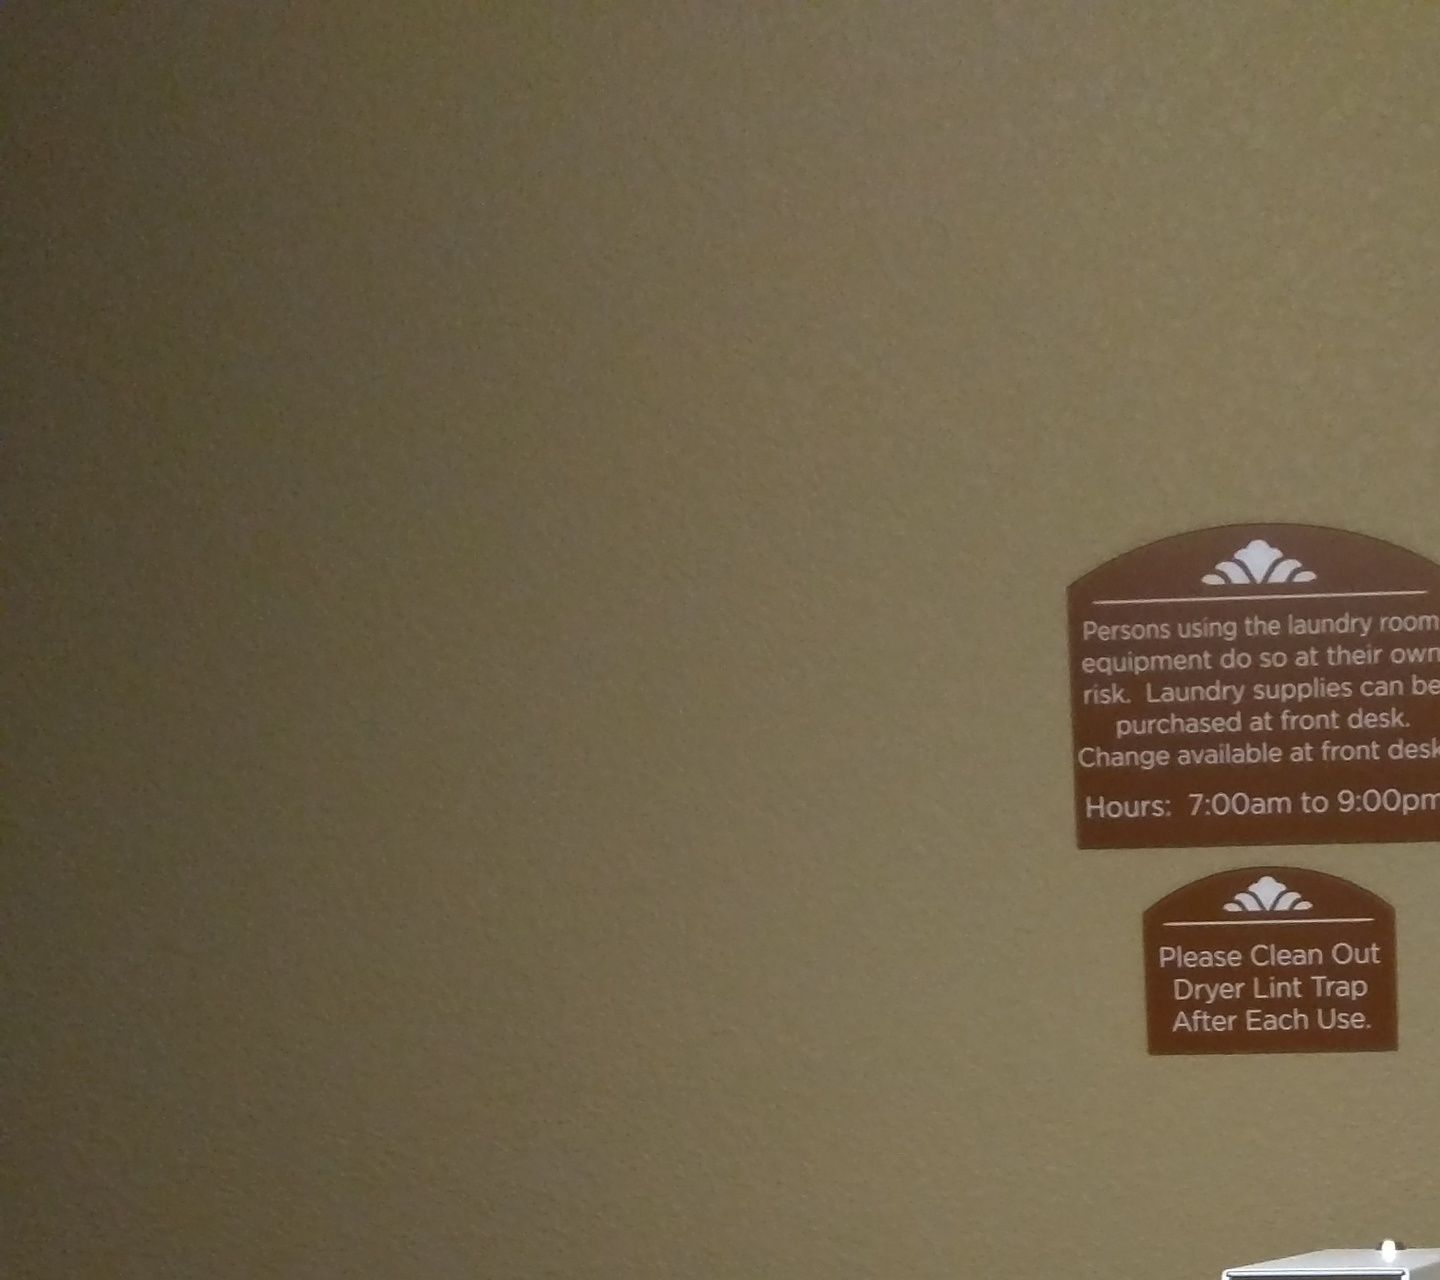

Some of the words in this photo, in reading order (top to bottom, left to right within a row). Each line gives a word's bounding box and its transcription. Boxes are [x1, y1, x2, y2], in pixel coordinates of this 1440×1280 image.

[1082, 620, 1171, 641] Persons
[1177, 618, 1237, 643] using
[1245, 615, 1281, 637] the
[1288, 613, 1371, 637] laundry
[1380, 613, 1440, 633] room
[1081, 651, 1212, 675] equipment
[1220, 648, 1252, 669] do
[1260, 652, 1288, 668] so
[1295, 649, 1318, 667] at
[1327, 645, 1383, 665] their
[1083, 684, 1131, 705] risk.
[1146, 682, 1245, 705] Laundry
[1253, 678, 1353, 702] supplies
[1360, 678, 1404, 697] can
[1116, 712, 1241, 739] purchased
[1250, 713, 1272, 732] at
[1281, 710, 1340, 730] front
[1348, 708, 1411, 729] desk.
[1078, 747, 1170, 770] Change
[1177, 743, 1282, 766] available
[1290, 744, 1313, 762] at
[1321, 741, 1380, 761] front
[1086, 797, 1172, 819] Hours:
[1188, 793, 1292, 816] 7:00am
[1301, 793, 1329, 814] to
[1159, 946, 1242, 968] Please
[1251, 944, 1322, 966] Clean
[1332, 943, 1381, 965] Out
[1174, 978, 1245, 1004] Dryer
[1254, 977, 1302, 999] Lint
[1310, 976, 1368, 1001] Trap
[1172, 1010, 1237, 1032] After
[1246, 1009, 1308, 1031] Each
[1317, 1008, 1371, 1030] Use.
